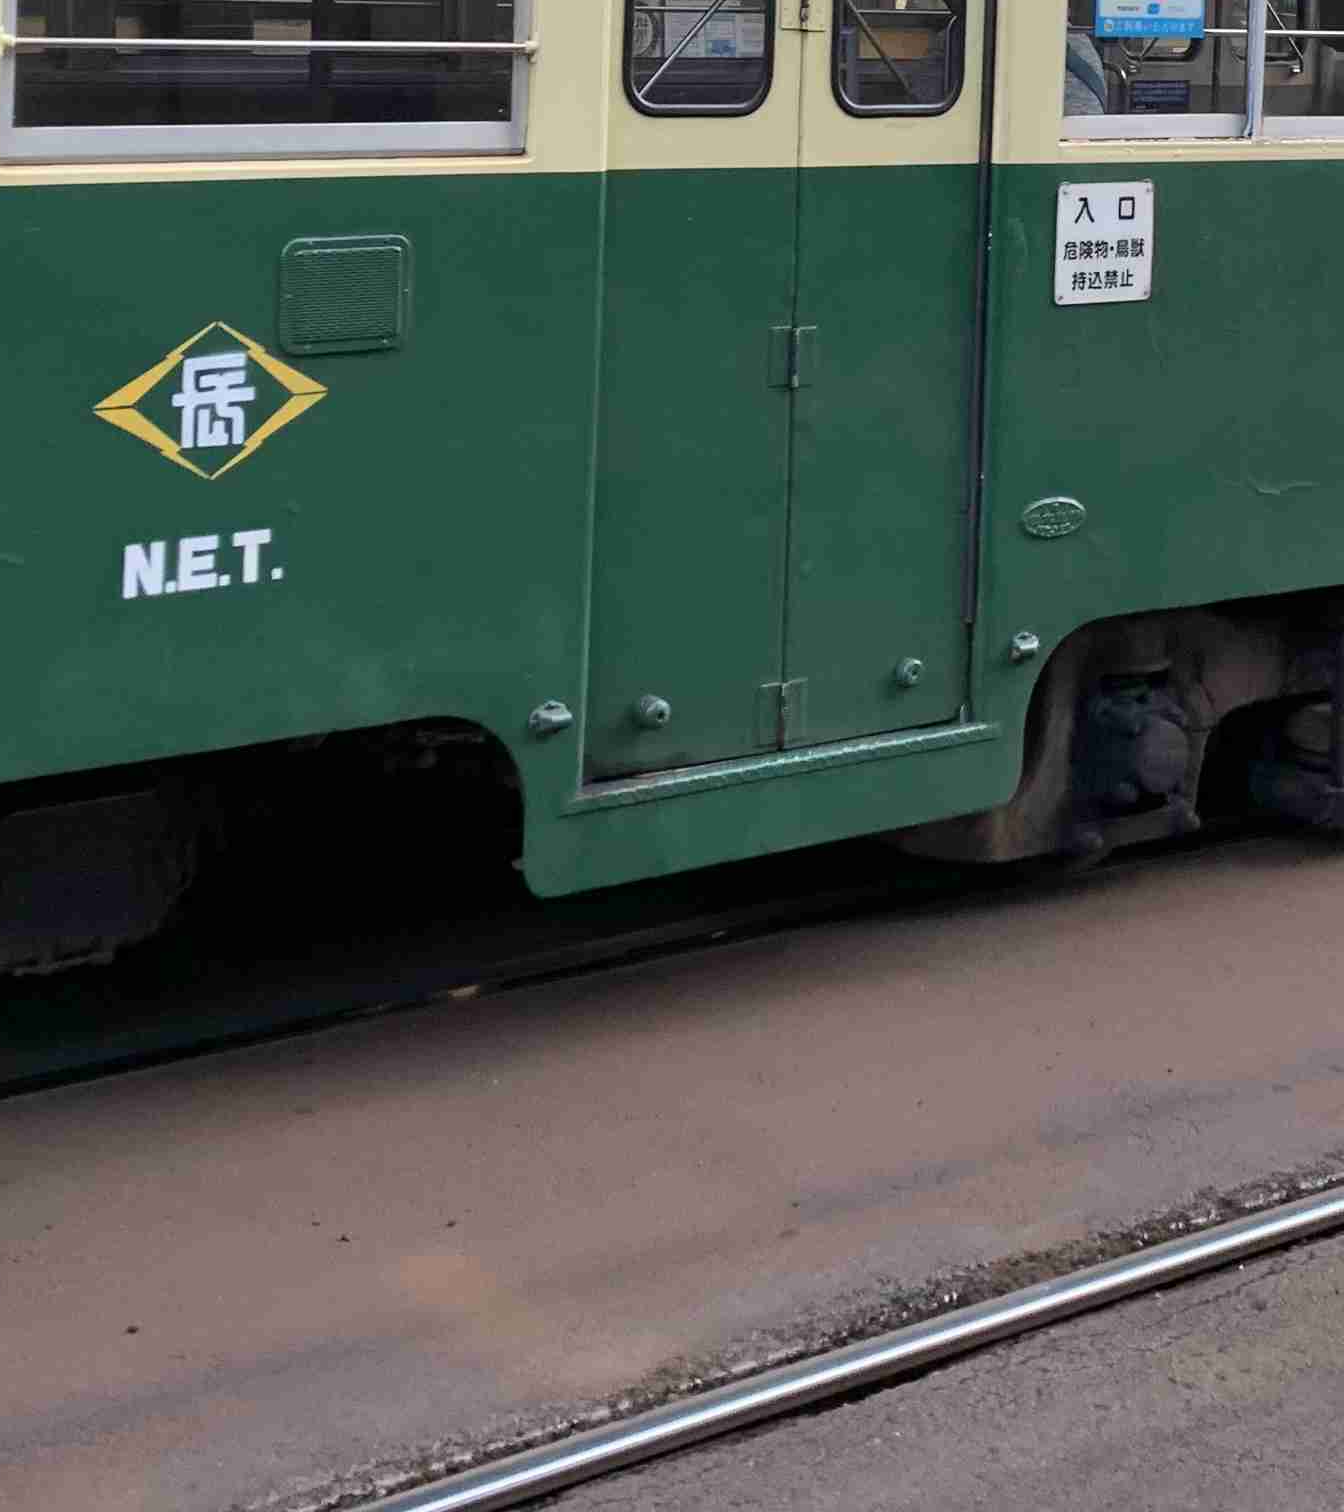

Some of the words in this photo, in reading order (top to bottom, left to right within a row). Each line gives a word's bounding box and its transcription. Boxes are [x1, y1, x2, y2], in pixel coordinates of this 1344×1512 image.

[1074, 196, 1135, 224] 入口
[1072, 269, 1134, 291] 持込禁止
[122, 528, 285, 600] N.E.T.
